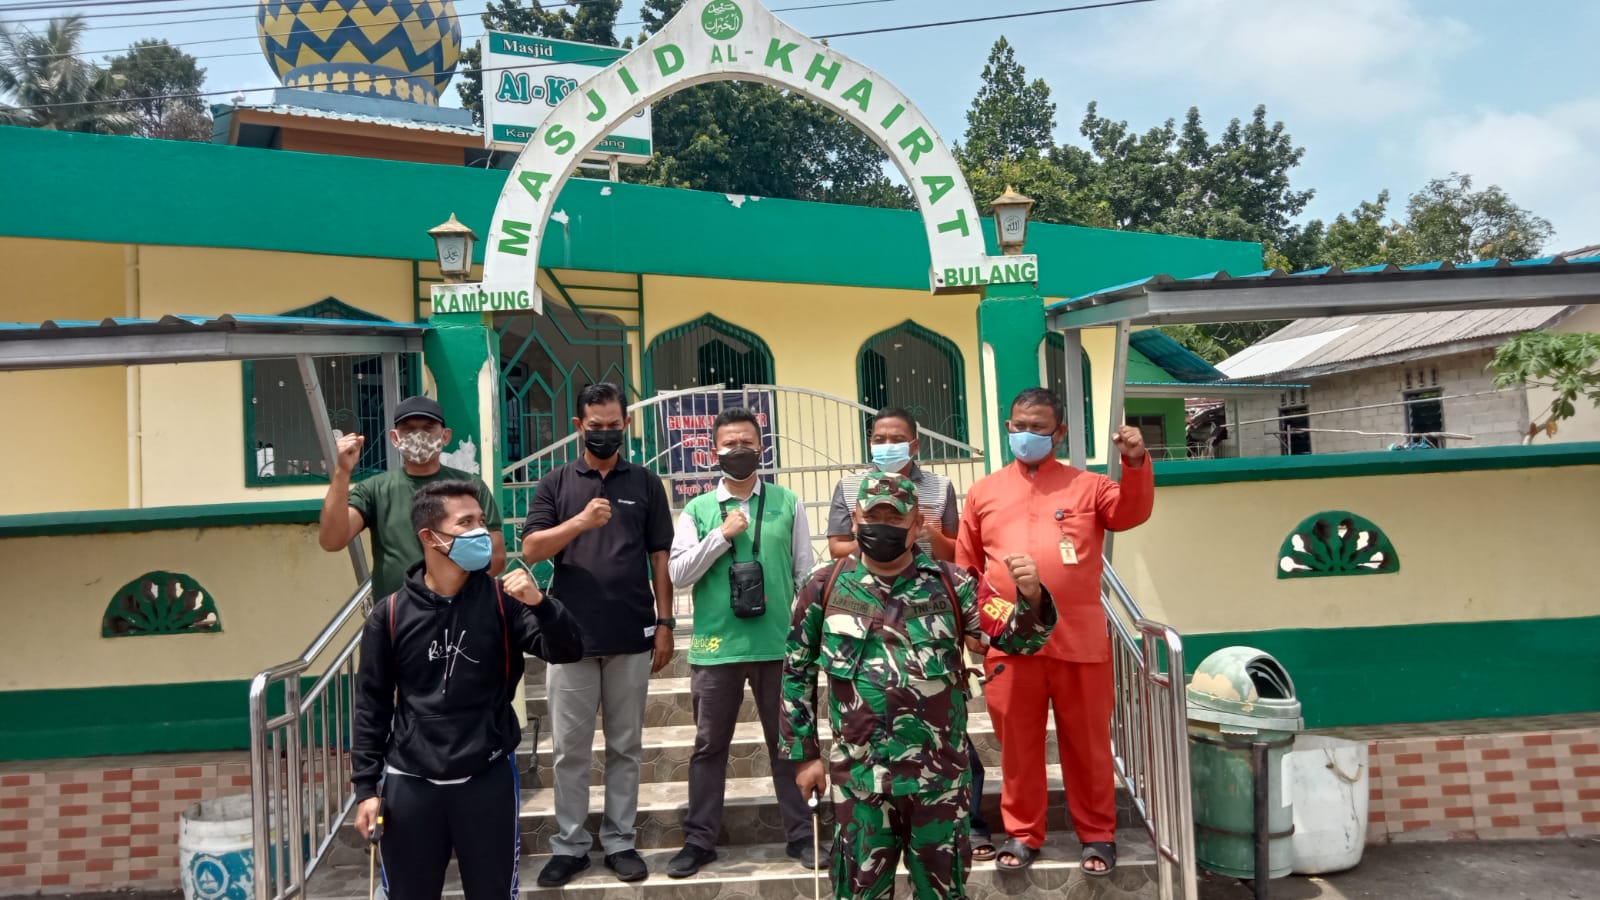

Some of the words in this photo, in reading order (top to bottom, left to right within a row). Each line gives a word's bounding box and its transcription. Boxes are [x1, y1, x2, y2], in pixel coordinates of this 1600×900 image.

[503, 39, 553, 58] Masjid
[498, 43, 685, 256] MASJID
[943, 262, 1037, 286] BULANG
[433, 290, 530, 312] KAMPUNG
[912, 600, 947, 614] TNI-AD
